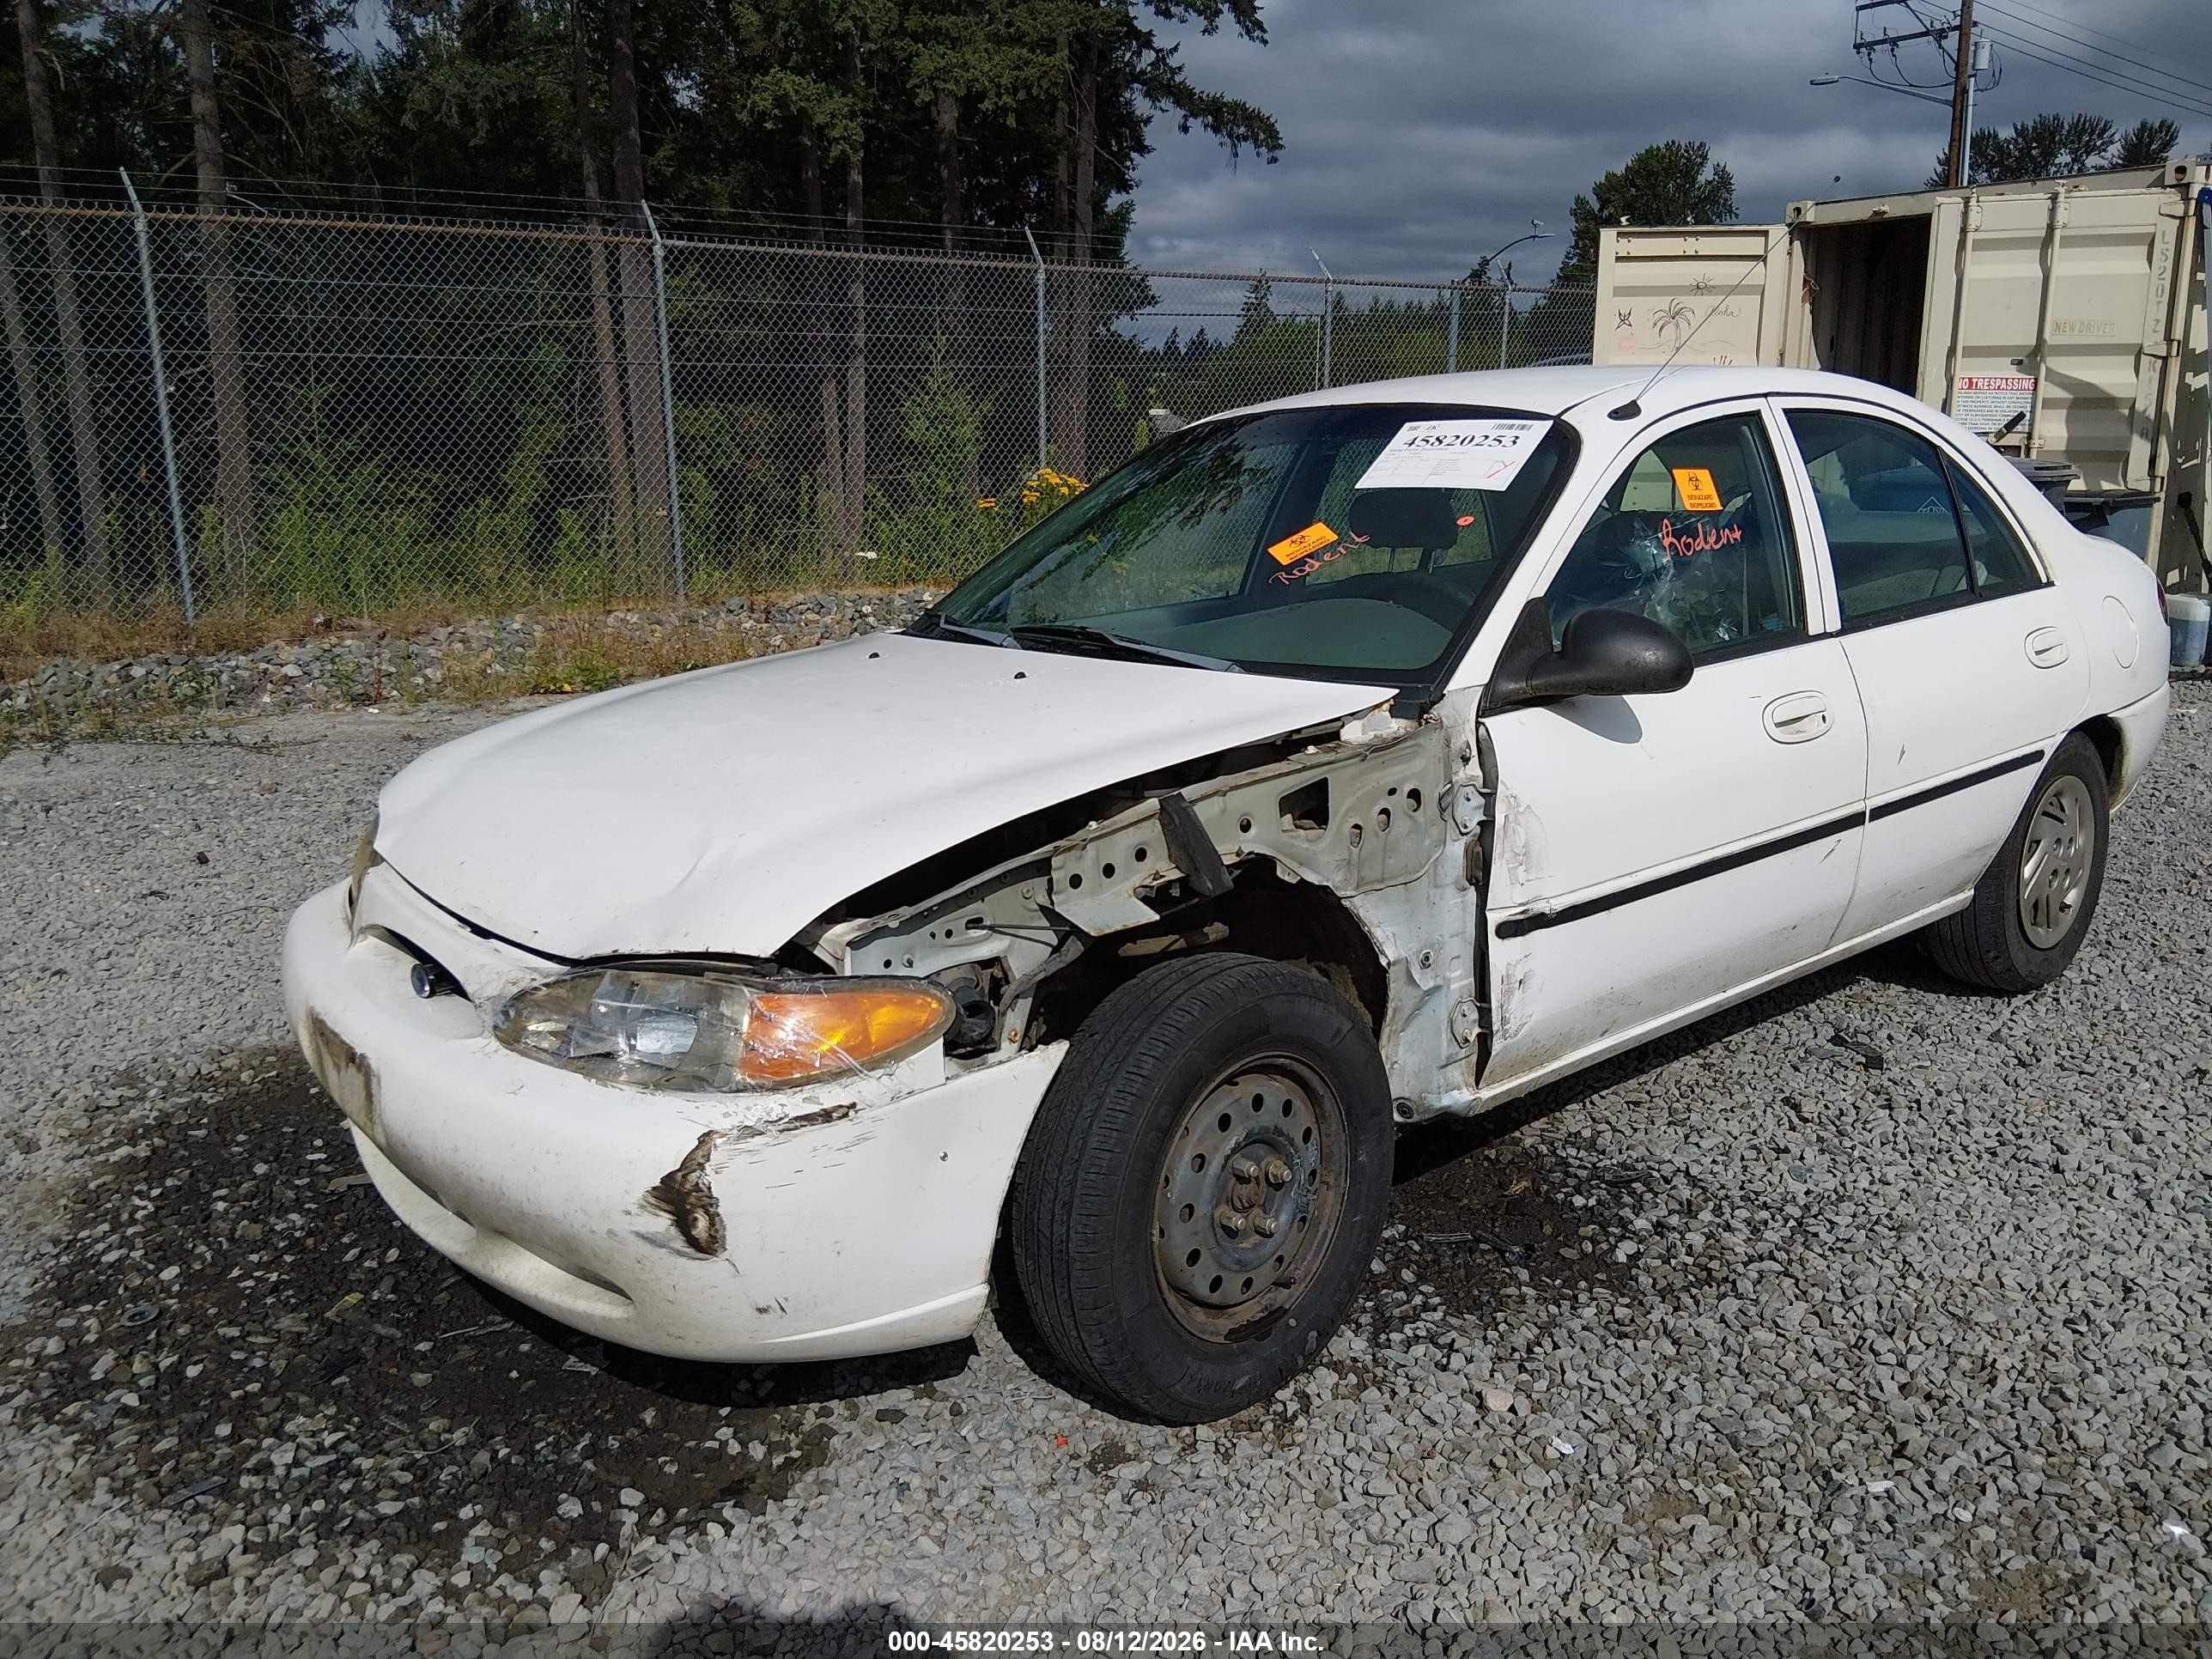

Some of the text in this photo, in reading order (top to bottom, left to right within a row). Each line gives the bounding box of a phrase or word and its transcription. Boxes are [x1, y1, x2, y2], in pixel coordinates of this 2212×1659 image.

[2054, 322, 2116, 334] NEW DRIVER
[1972, 378, 2035, 390] TRESPASSING
[1403, 434, 1521, 448] 45820253
[1662, 518, 1742, 561] Rodent
[1268, 531, 1370, 585] Rodent
